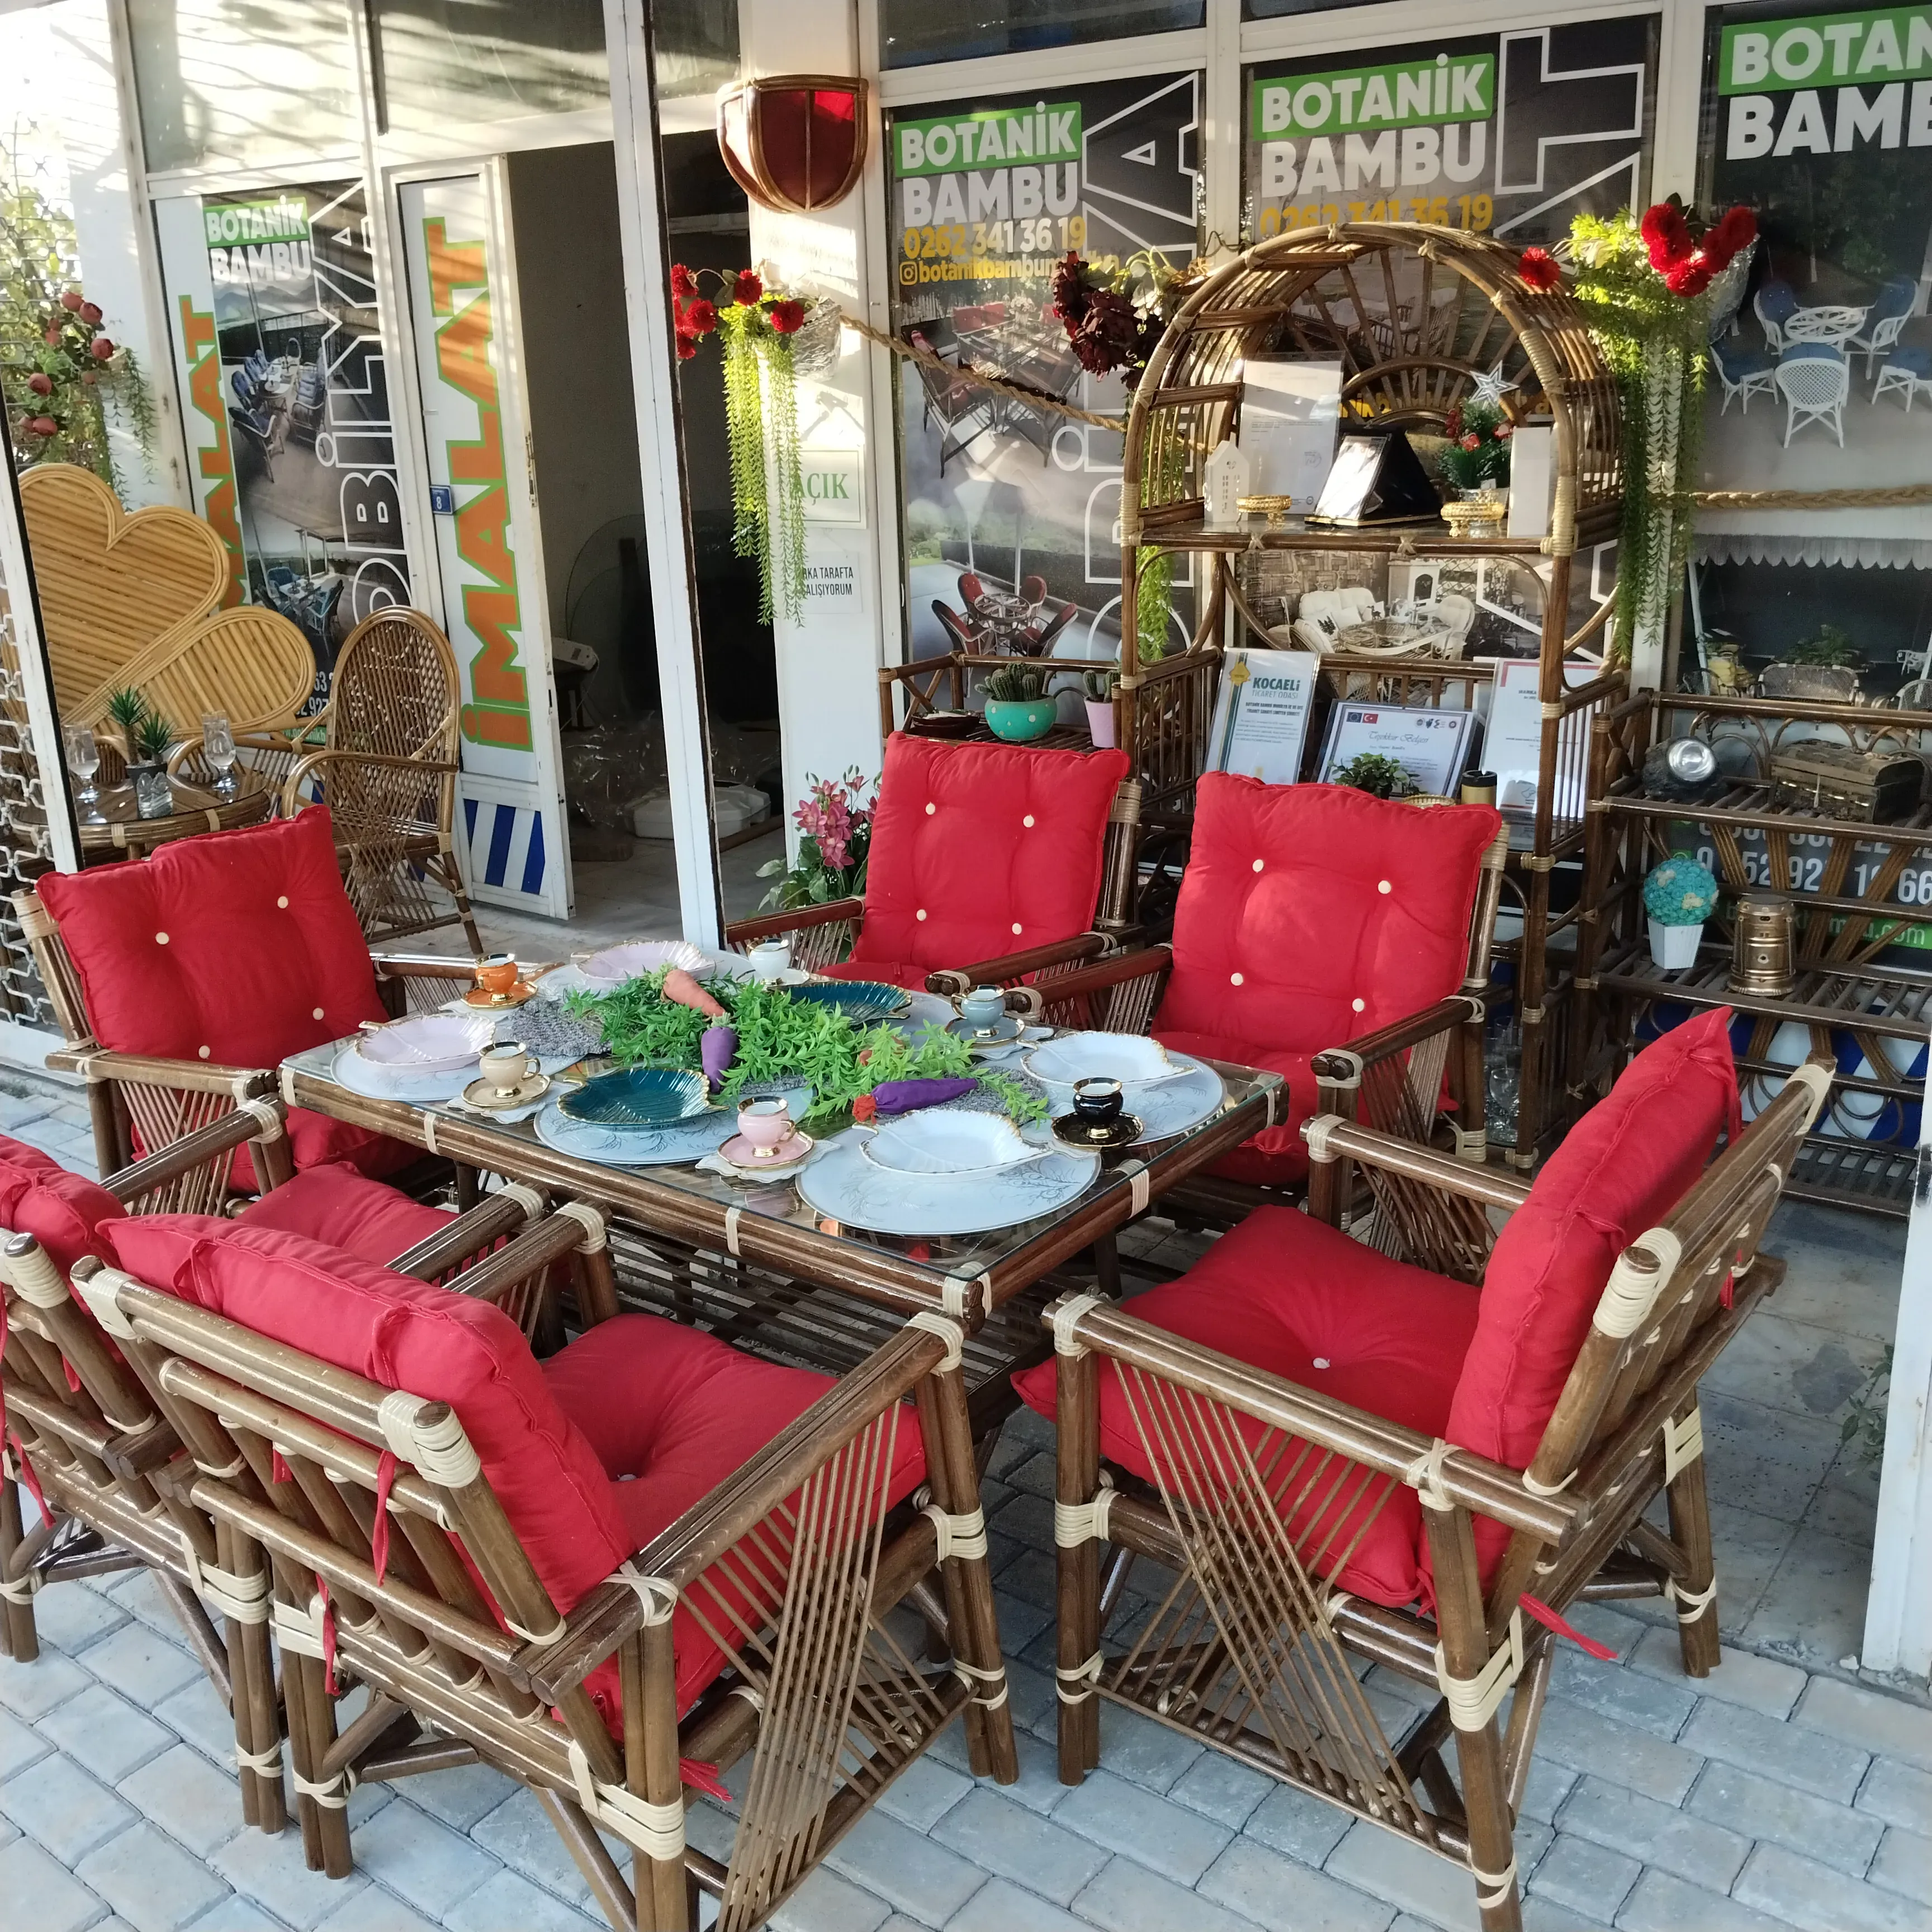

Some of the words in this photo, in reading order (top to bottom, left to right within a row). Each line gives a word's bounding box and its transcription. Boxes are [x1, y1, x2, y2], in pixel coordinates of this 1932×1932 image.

[1261, 53, 1488, 133] BOTANİK
[901, 101, 1077, 169] BOTANİK
[1261, 121, 1488, 198] BAMBU
[205, 195, 306, 242] BOTANİK
[903, 162, 1079, 228] BAMBU
[1458, 193, 1494, 231] 19
[904, 224, 966, 259] 0262
[972, 221, 1014, 255] 341
[1021, 219, 1052, 253] 36
[1059, 216, 1086, 250] 19
[210, 241, 311, 285] BAMBU
[423, 216, 534, 752] İMALAT
[436, 496, 442, 510] 8
[801, 567, 818, 580] RKA
[820, 567, 854, 579] TARAFTA
[804, 583, 853, 598] ALIŞIYORUM
[1789, 856, 1827, 892] 92
[1897, 868, 1932, 906] 66
